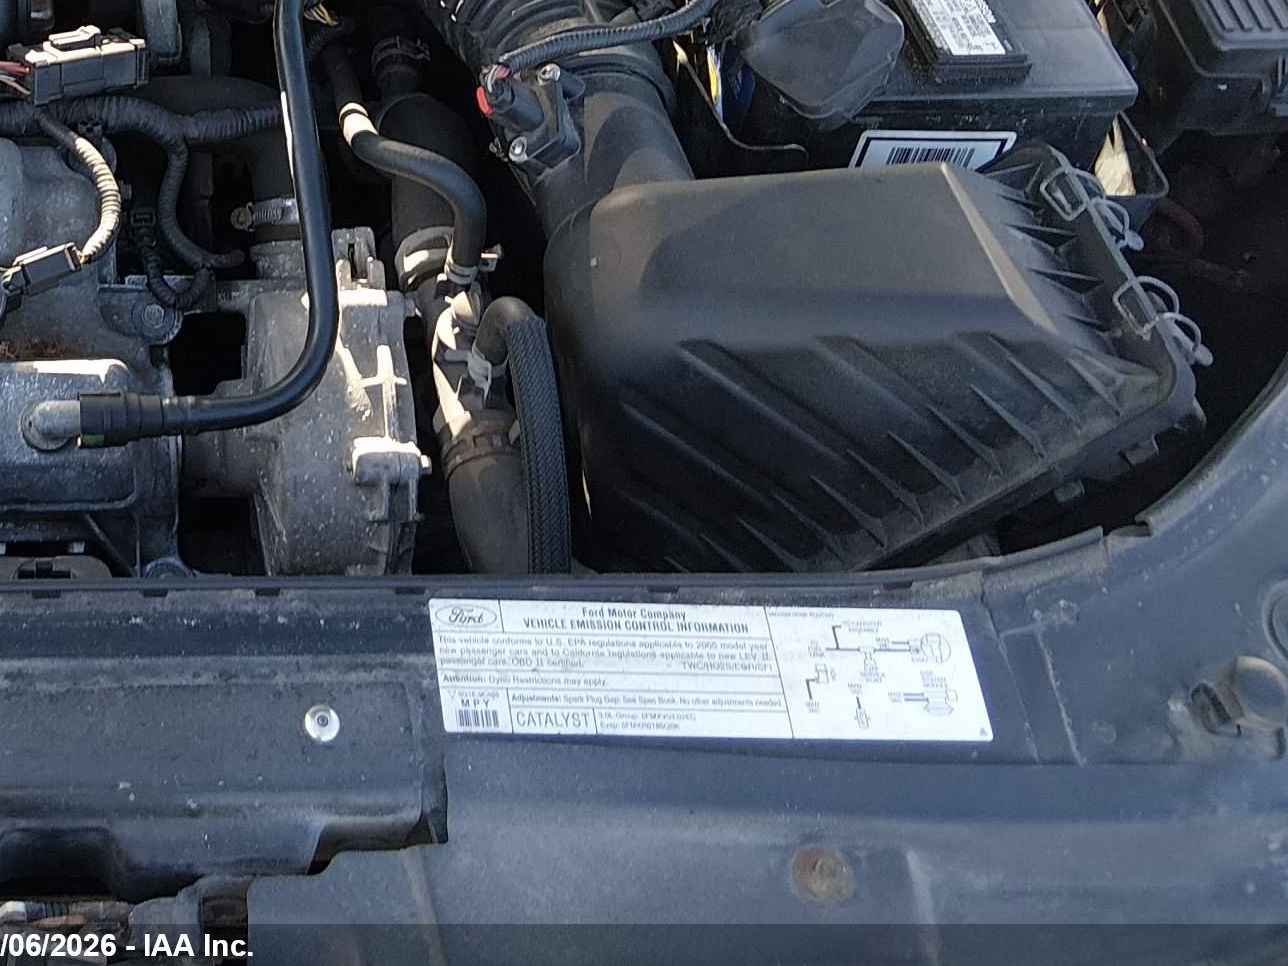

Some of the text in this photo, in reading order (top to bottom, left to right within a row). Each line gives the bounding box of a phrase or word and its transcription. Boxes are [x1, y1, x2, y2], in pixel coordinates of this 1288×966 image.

[448, 606, 484, 625] Ford
[582, 607, 686, 622] Ford Motor Company
[523, 618, 748, 634] VEHICLE EMISSION CONTROL INFORMATION
[460, 636, 489, 644] vehicle
[492, 637, 532, 646] conforms
[535, 638, 543, 646] to
[546, 638, 564, 646] U.S.
[568, 638, 586, 646] EPA
[588, 640, 636, 650] regulations
[639, 640, 682, 652] applicable
[720, 642, 746, 650] model
[748, 644, 768, 653] year
[440, 658, 485, 667] passenger
[512, 658, 532, 666] OBD
[460, 648, 506, 658] passenger
[509, 648, 528, 656] cars
[531, 648, 548, 656] and
[551, 648, 560, 656] to
[562, 648, 604, 658] California
[608, 650, 656, 660] regulations
[660, 651, 704, 662] applicable
[706, 652, 715, 660] to
[739, 652, 757, 661] LEV
[489, 676, 510, 684] Dyno
[513, 676, 561, 684] Restrictions
[564, 678, 582, 686] may
[564, 694, 583, 704] Spark
[586, 695, 602, 705] Plug
[623, 696, 636, 704] See
[712, 698, 754, 708] adjustments
[516, 712, 591, 728] CATALYST
